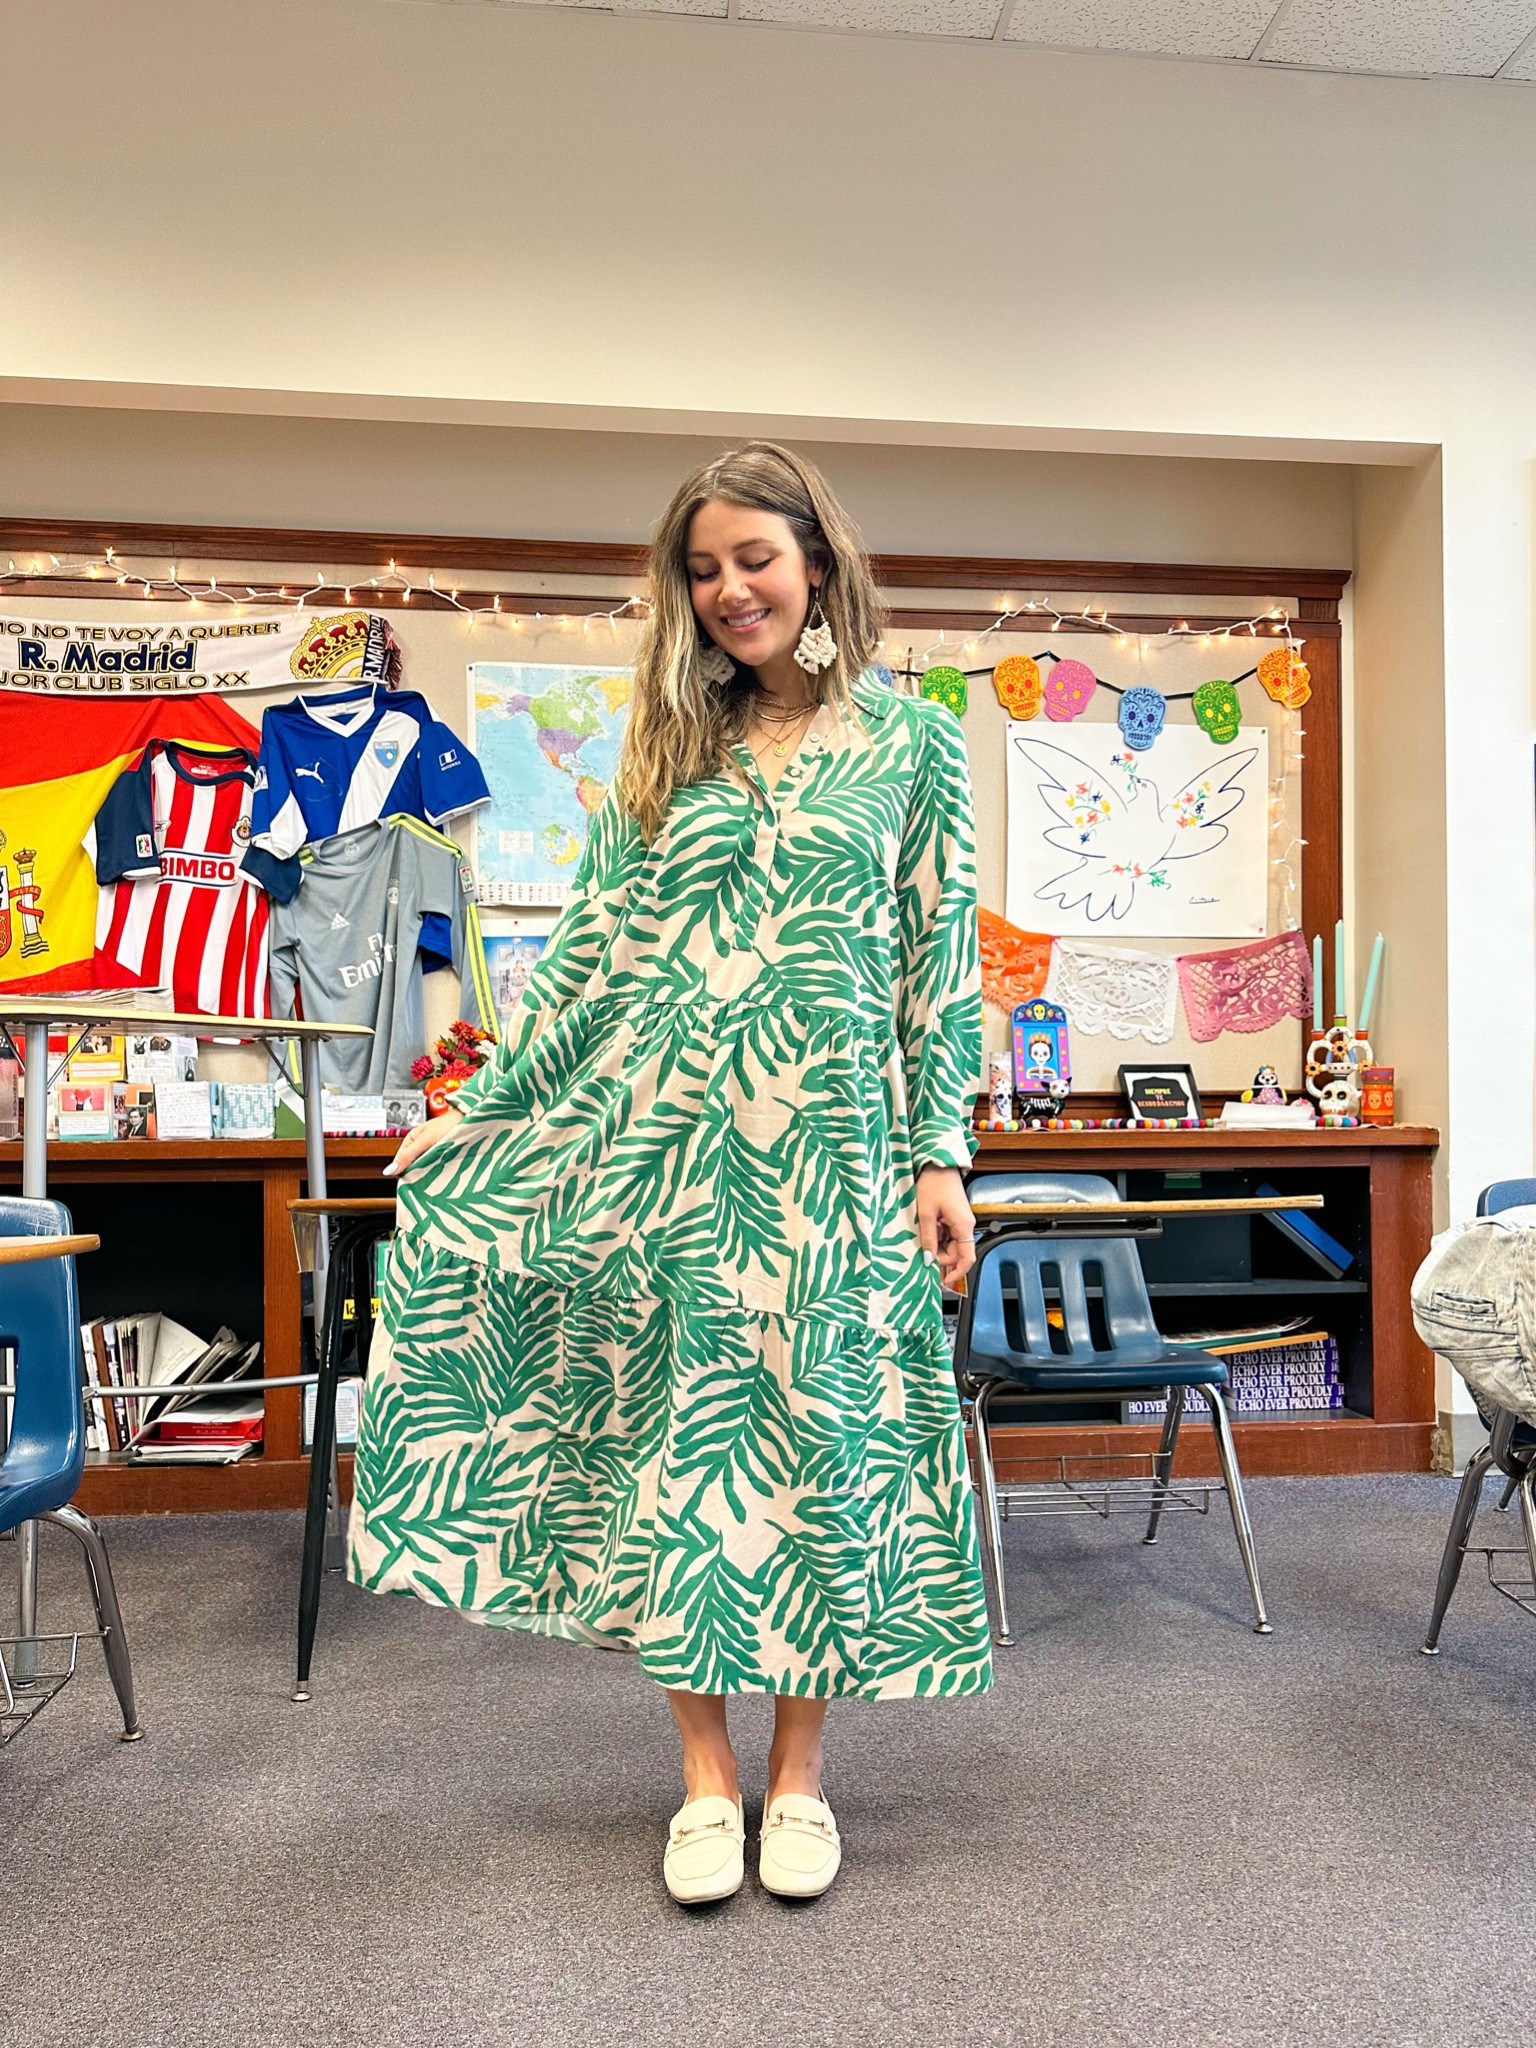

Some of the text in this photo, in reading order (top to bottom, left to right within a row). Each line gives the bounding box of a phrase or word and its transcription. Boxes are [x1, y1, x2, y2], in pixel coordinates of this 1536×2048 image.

[0, 621, 281, 641] O NO TE VOY A QUERER
[18, 638, 198, 673] R. Madrid
[53, 674, 124, 692] CLUB
[130, 674, 209, 691] SIGLO
[213, 670, 250, 688] XX
[1233, 1350, 1327, 1365] ECHO EVER PROUDLY
[1232, 1362, 1326, 1377] ECHO EVER PROUDLY
[1232, 1374, 1326, 1388] ECHO EVER PROUDLY
[1240, 1387, 1265, 1399] ECHO
[1267, 1386, 1290, 1399] EVER
[1291, 1385, 1333, 1397] PROUDLY
[1128, 1401, 1142, 1414] HO
[1144, 1400, 1168, 1413] EVER
[1238, 1397, 1331, 1411] ECHO EVER PROUDLY
